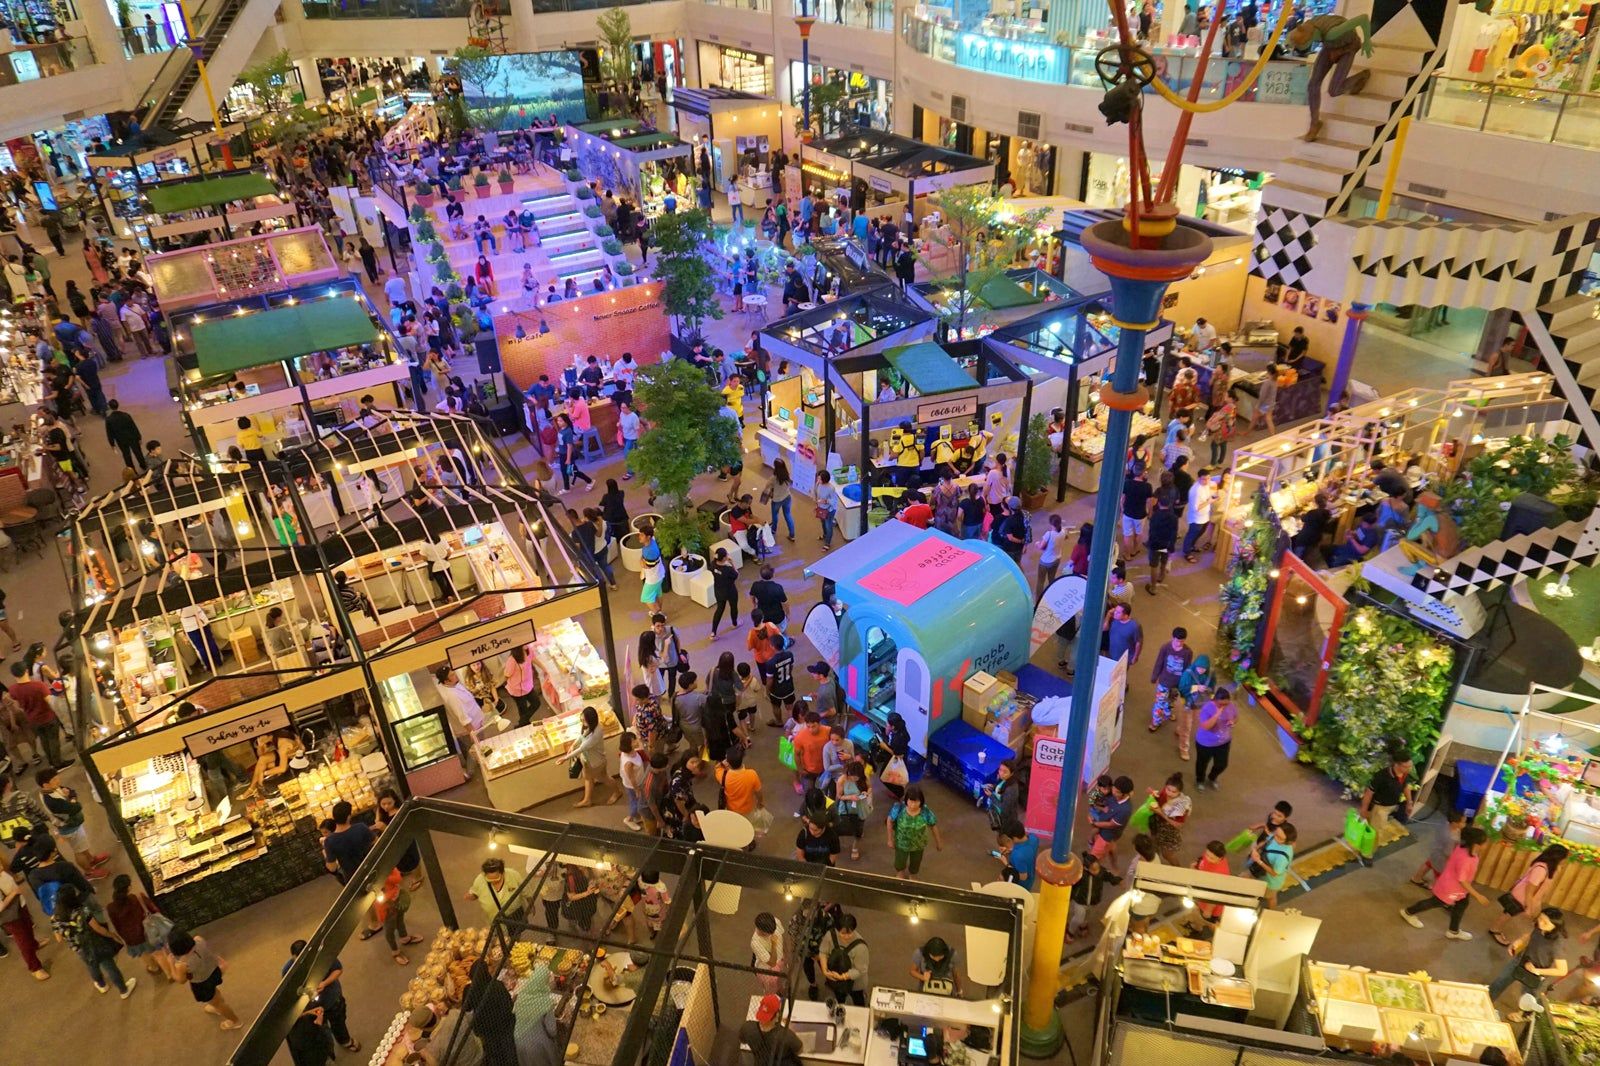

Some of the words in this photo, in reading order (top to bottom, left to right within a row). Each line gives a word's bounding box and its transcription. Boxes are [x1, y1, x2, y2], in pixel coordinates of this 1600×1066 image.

[593, 313, 613, 321] Never
[613, 307, 637, 317] Snooze
[638, 302, 660, 312] Coffee
[778, 663, 791, 684] 31
[1041, 744, 1065, 755] Rab
